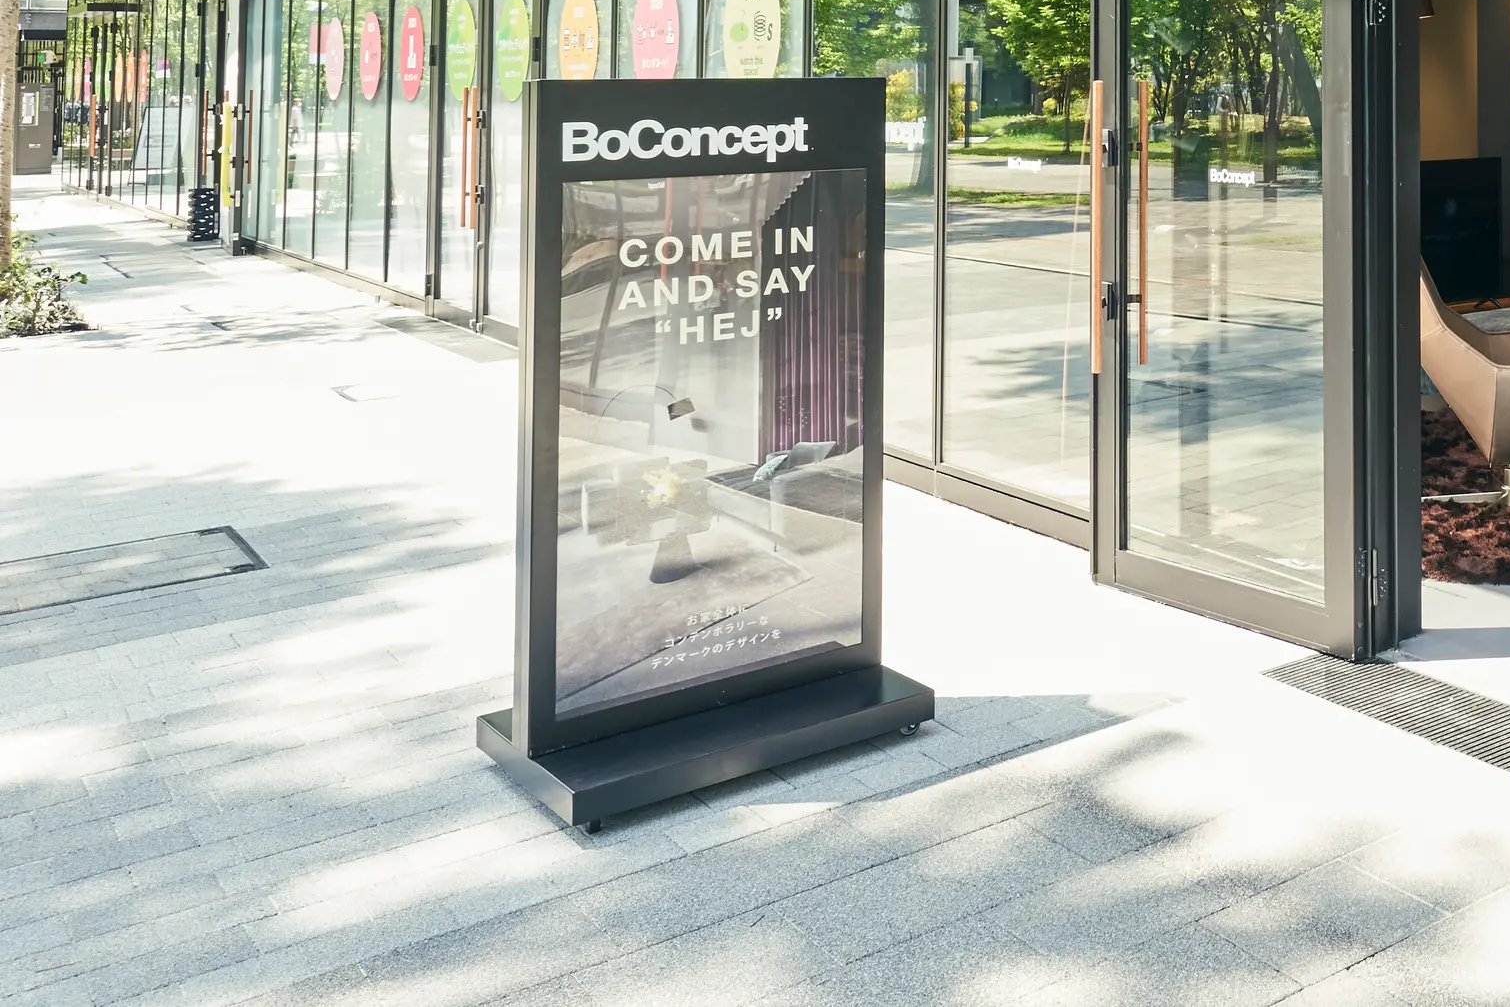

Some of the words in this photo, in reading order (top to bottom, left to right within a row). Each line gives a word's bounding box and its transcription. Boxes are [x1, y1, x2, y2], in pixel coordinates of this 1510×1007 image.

[619, 230, 753, 268] COME
[774, 225, 814, 256] IN
[617, 274, 714, 311] AND
[735, 264, 815, 298] SAY
[686, 603, 748, 627] お家全体に
[651, 629, 782, 670] デンマークのデザインを
